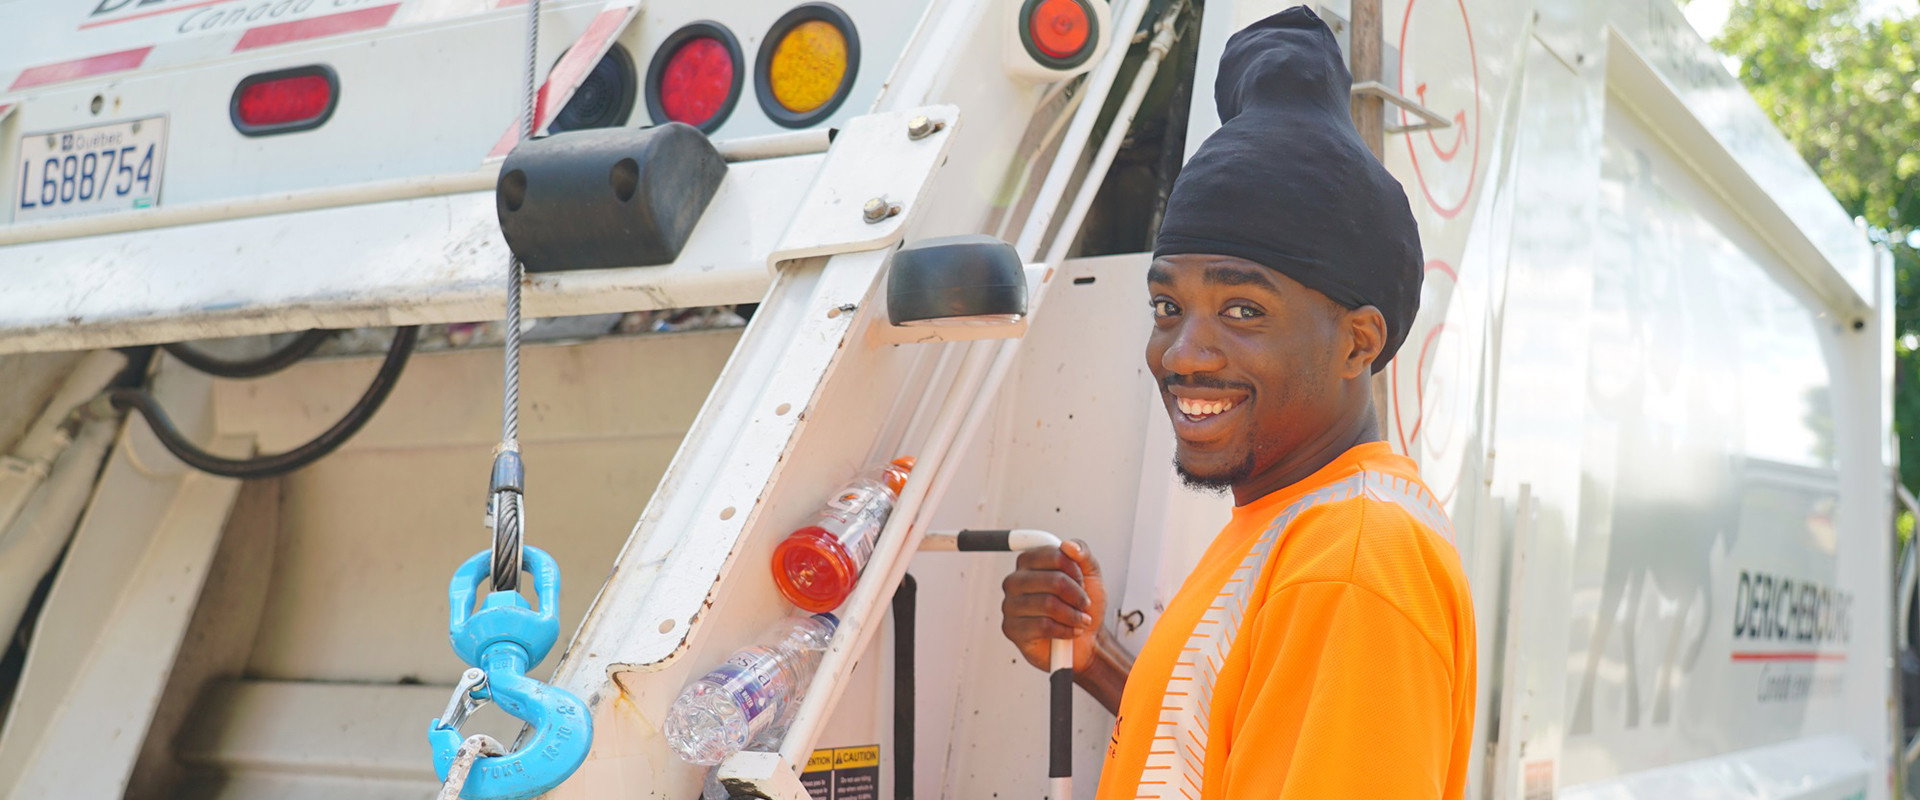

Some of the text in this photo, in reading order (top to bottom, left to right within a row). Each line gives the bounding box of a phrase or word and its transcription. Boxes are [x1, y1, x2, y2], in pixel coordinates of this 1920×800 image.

[20, 143, 156, 210] L688754
[808, 756, 831, 766] ENTION
[843, 750, 877, 763] CAUTION
